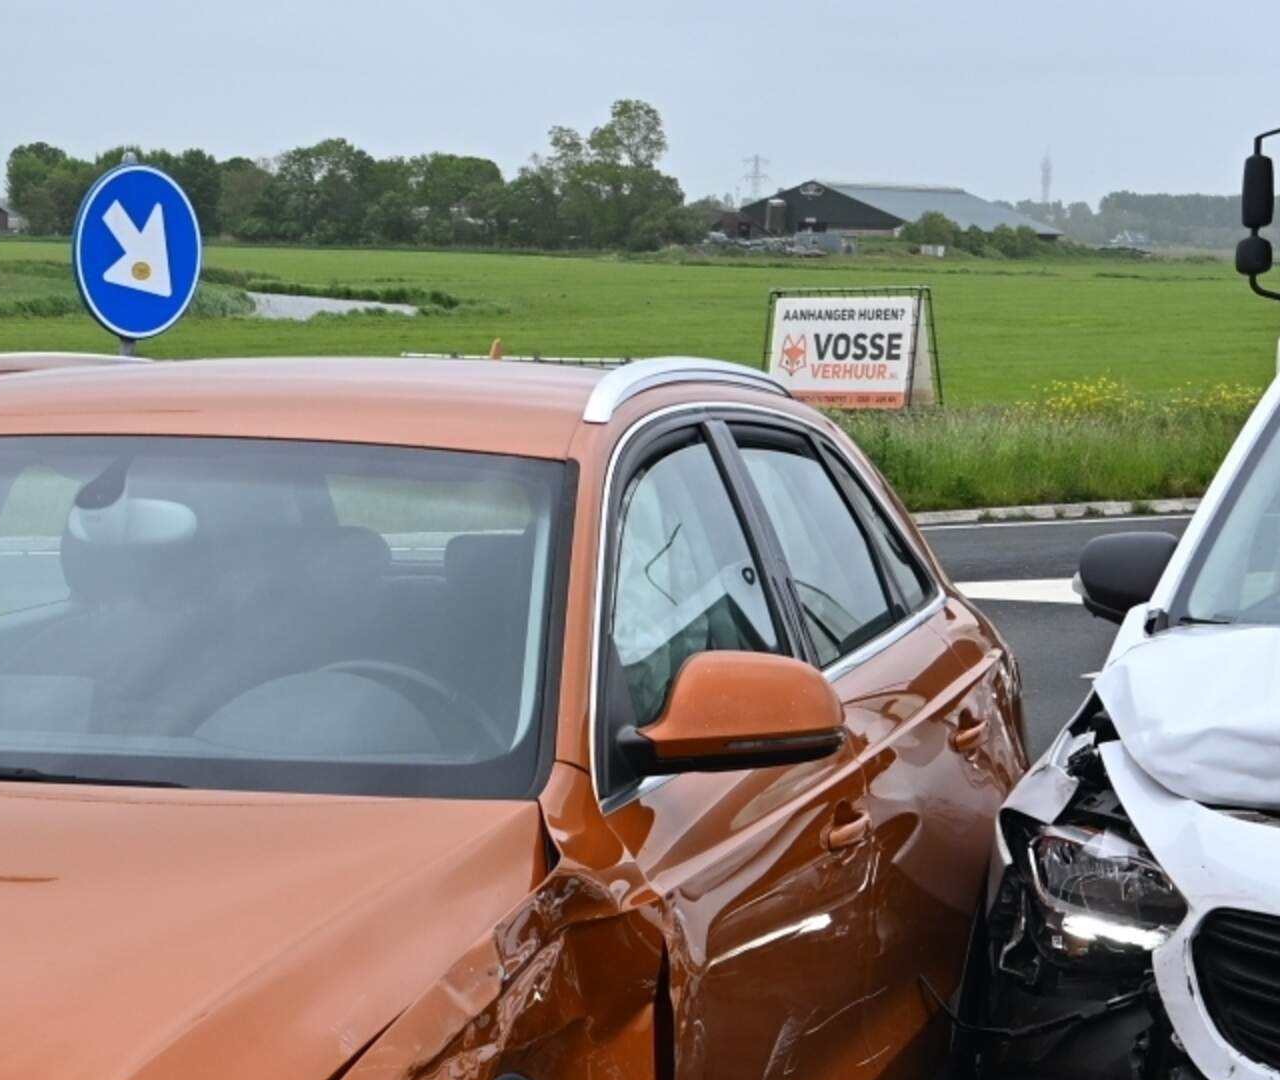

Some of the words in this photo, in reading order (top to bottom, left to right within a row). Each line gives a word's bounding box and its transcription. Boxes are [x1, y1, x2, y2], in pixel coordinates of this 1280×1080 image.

[783, 309, 856, 321] AANHANGER
[857, 308, 905, 321] HUREN?
[814, 332, 903, 361] VOSSE
